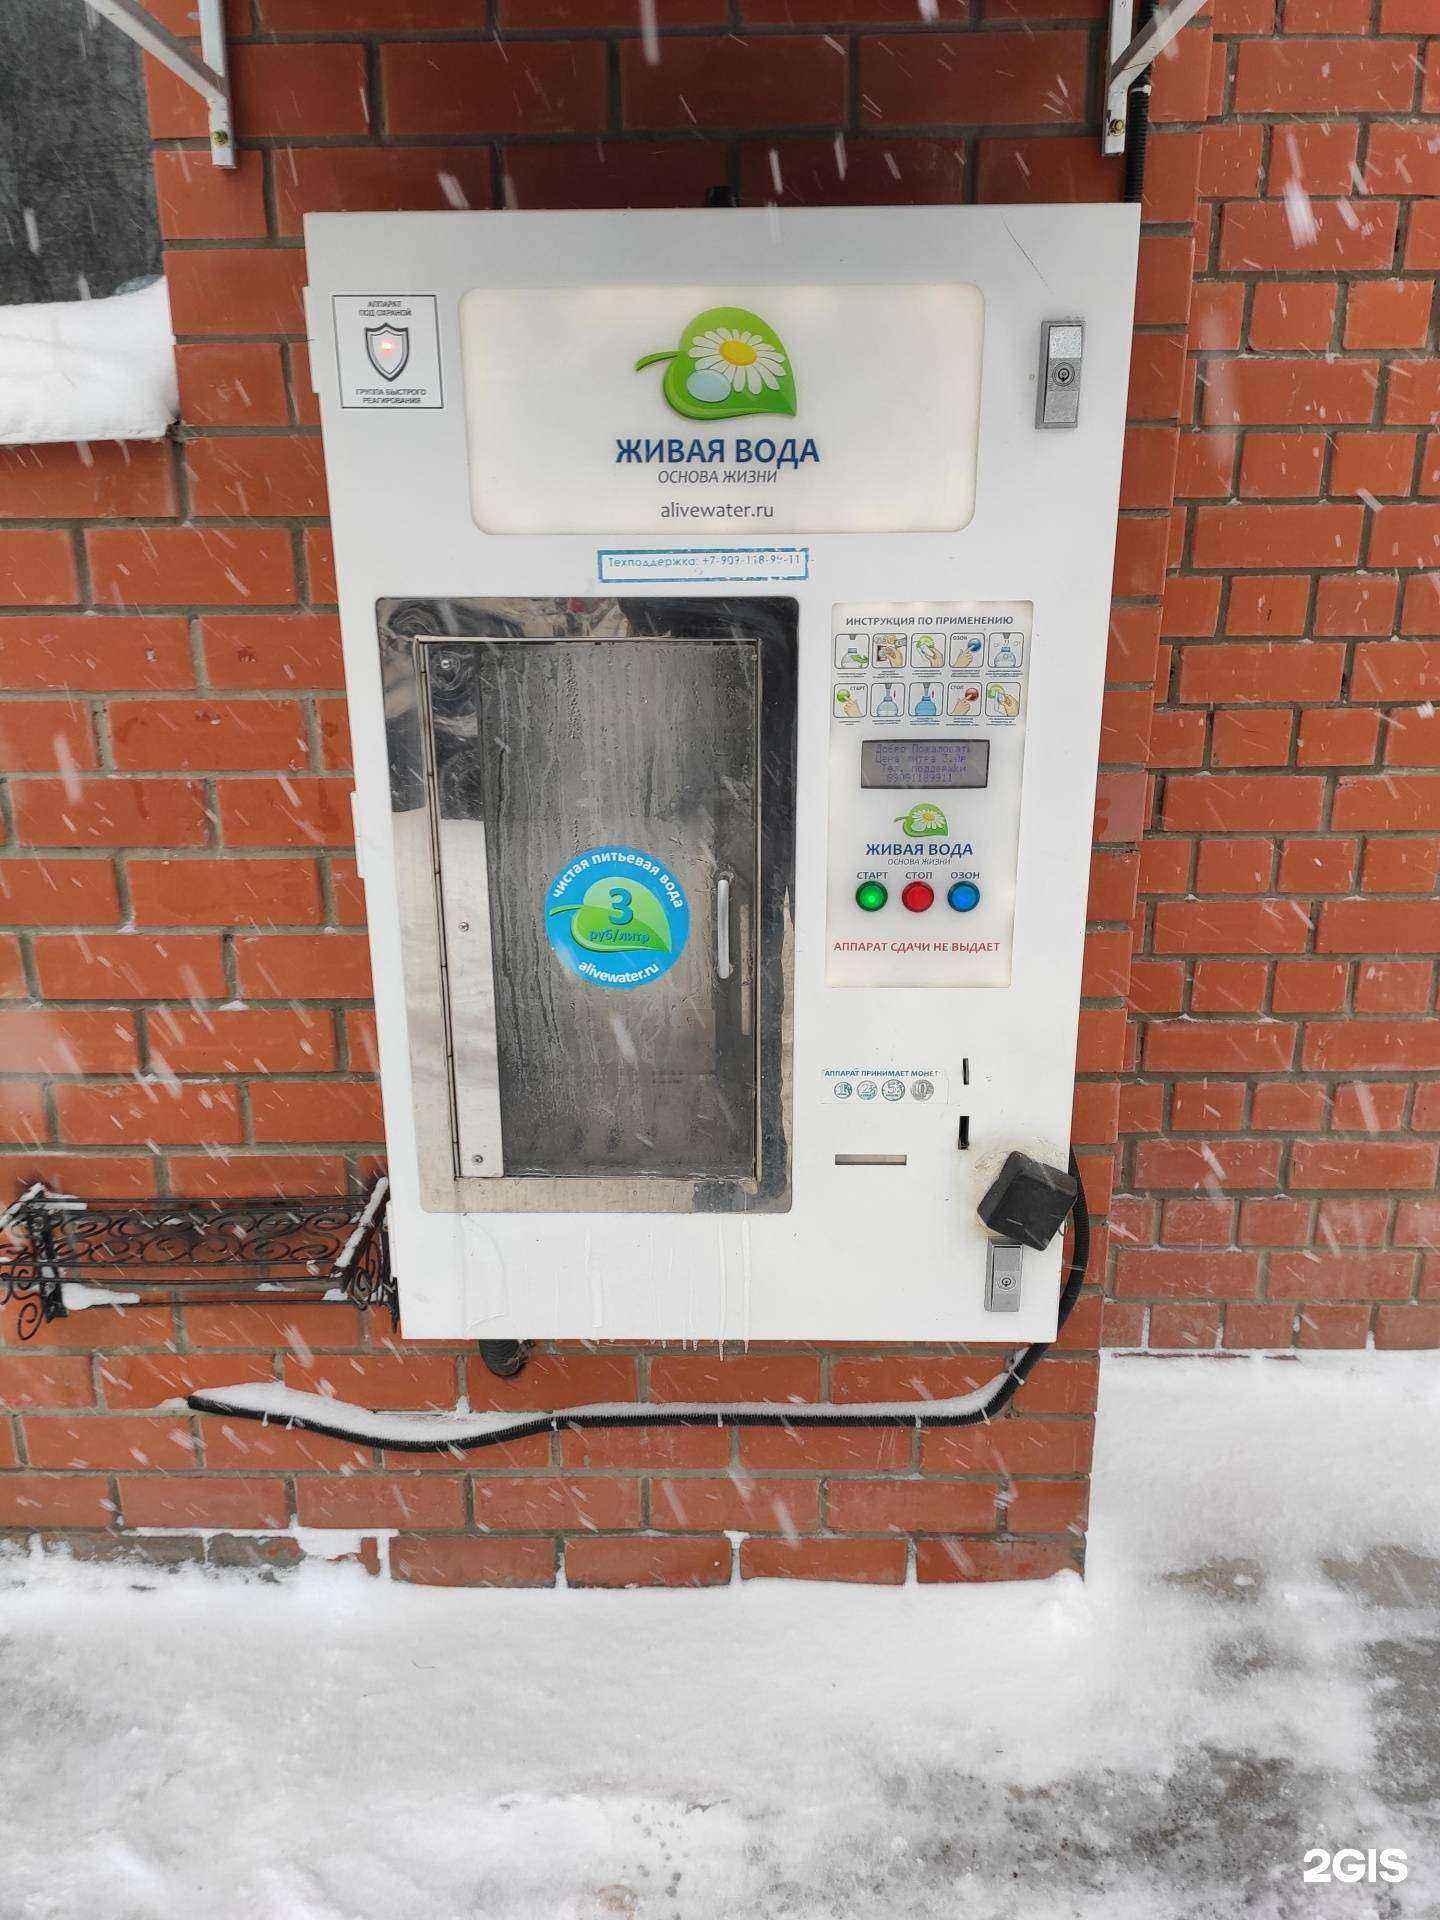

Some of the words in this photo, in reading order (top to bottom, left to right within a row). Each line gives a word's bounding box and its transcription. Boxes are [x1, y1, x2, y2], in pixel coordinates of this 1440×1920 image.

[385, 388, 427, 396] БЫСТРОГО
[615, 438, 725, 463] ЖИВАЯ
[735, 438, 820, 469] ВОДА
[657, 470, 719, 484] ОСНОВА
[722, 470, 778, 484] ЖИЗНИ
[660, 501, 775, 518] alivewater.ru
[845, 616, 915, 628] ИНСТРУКЦИЯ
[918, 616, 934, 626] ПО
[936, 616, 1014, 626] ПРИМЕНЕНИЮ
[865, 843, 924, 856] ЖИВАЯ
[929, 843, 973, 858] ВОДА
[887, 858, 920, 866] ОСНОВА
[922, 858, 951, 866] ЖИЗНИ
[552, 859, 591, 898] чистая
[591, 852, 660, 876] питьевая
[658, 873, 684, 908] вода
[856, 871, 888, 880] СТАРТ
[905, 871, 933, 880] СТОП
[950, 871, 980, 880] ОЗОН
[608, 887, 634, 925] 3
[588, 929, 650, 945] руб/литр
[833, 942, 888, 952] АППАРАТ
[890, 942, 930, 954] СДАЧИ
[933, 942, 949, 952] НЕ
[951, 942, 1001, 954] ВЫДАЕТ
[578, 961, 660, 983] alivewater.ru
